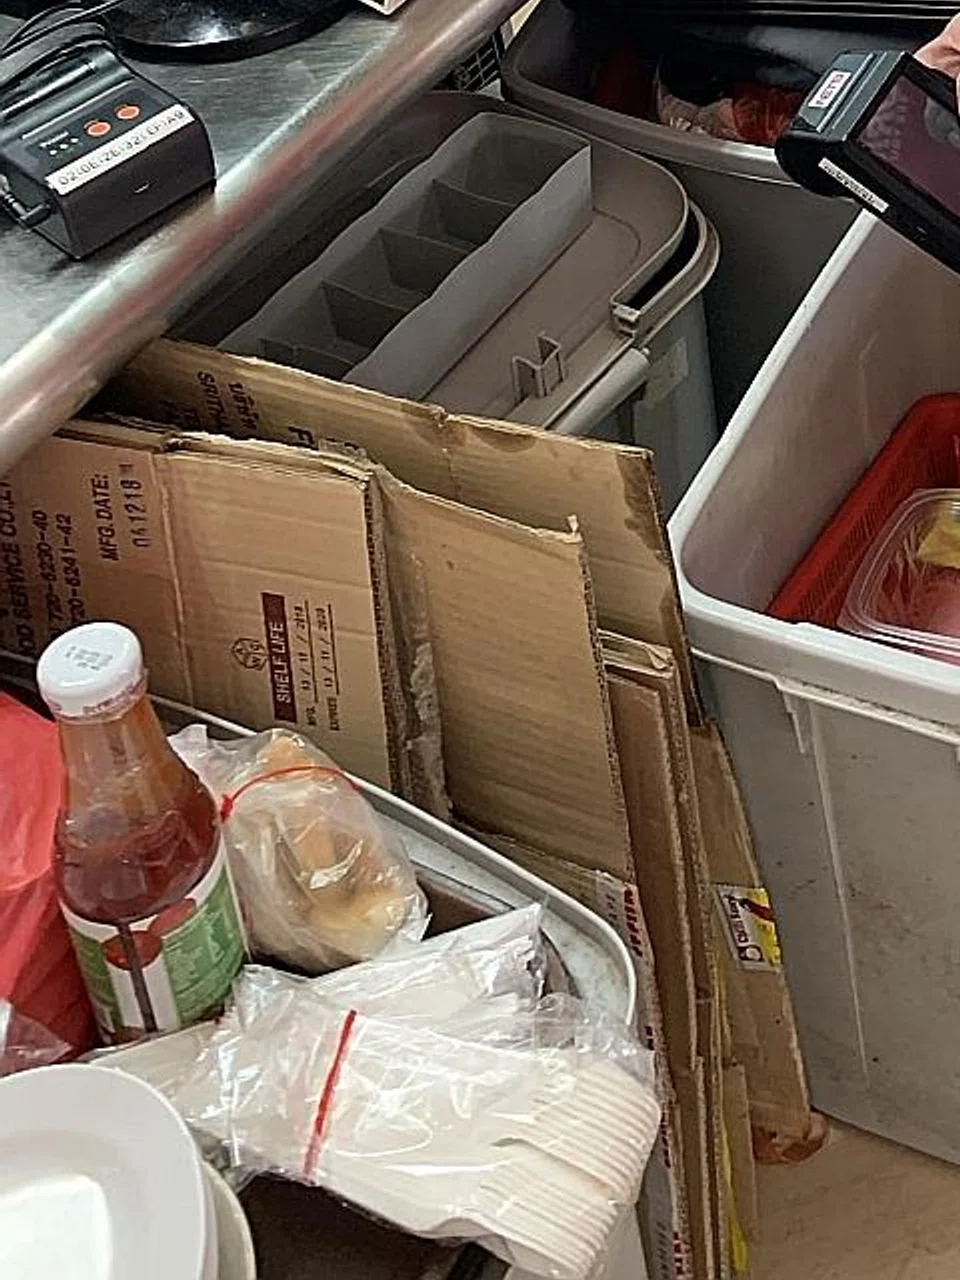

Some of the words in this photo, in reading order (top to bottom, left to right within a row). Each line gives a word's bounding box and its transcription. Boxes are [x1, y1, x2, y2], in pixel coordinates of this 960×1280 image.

[3, 543, 31, 622] SERVICE
[270, 620, 287, 653] LIFE
[271, 655, 292, 704] SHELF
